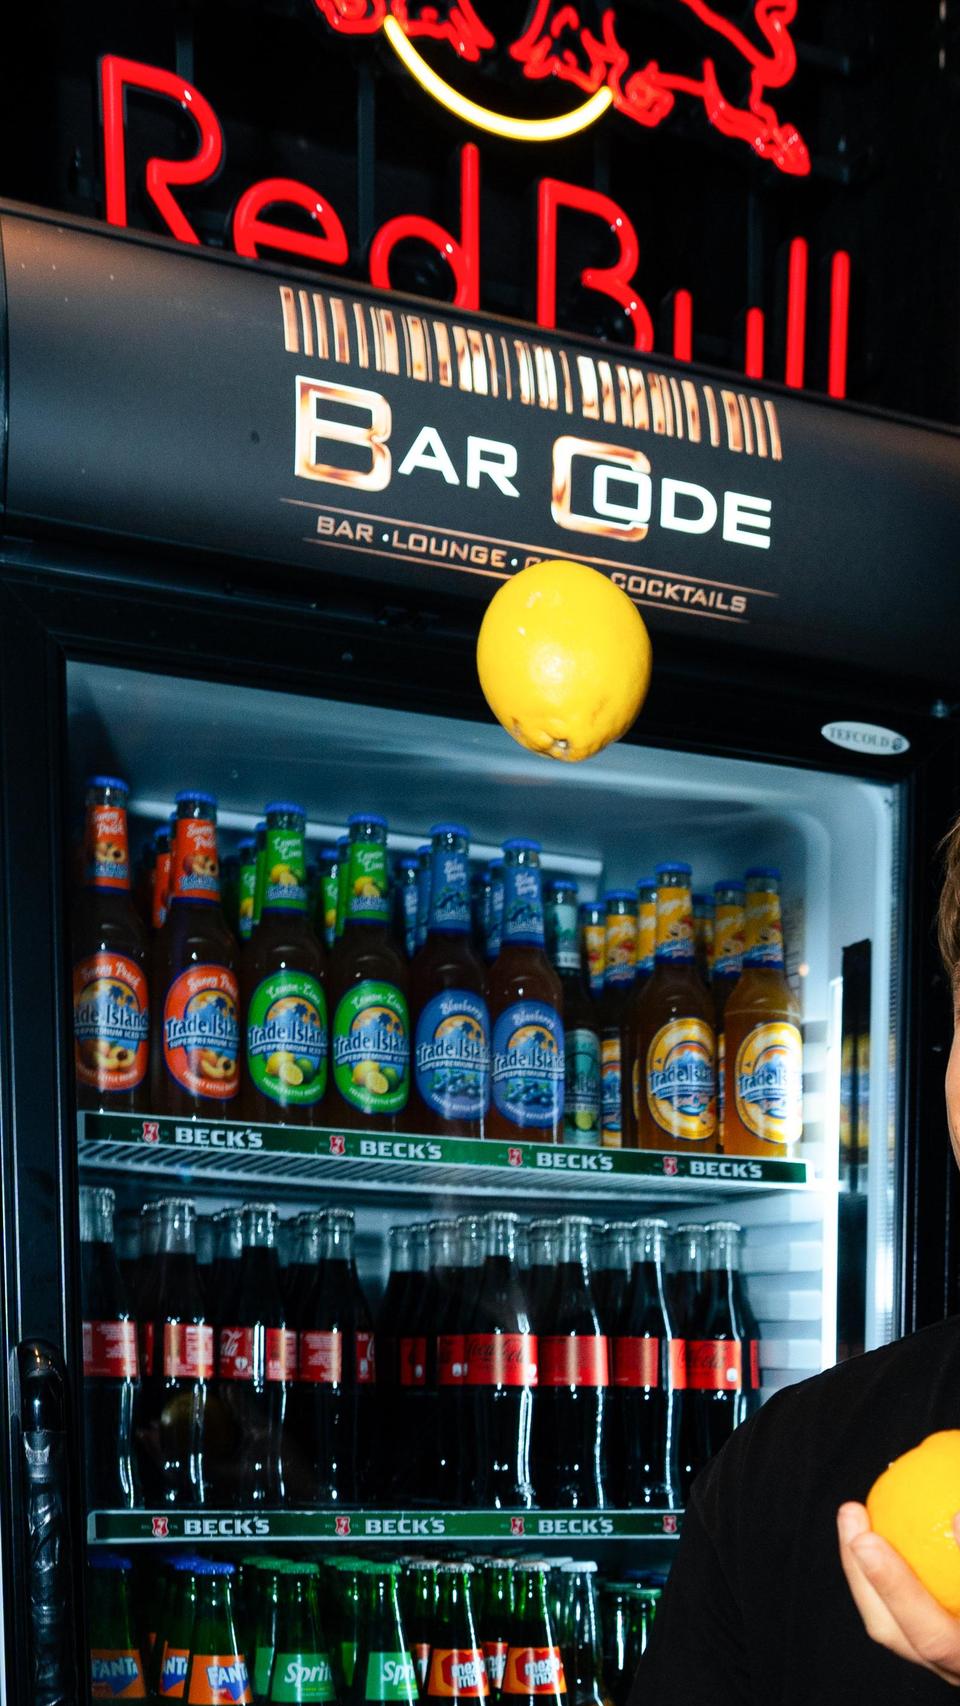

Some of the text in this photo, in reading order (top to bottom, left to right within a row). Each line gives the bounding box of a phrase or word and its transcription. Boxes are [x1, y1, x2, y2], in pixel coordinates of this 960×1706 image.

[100, 54, 481, 311] Red
[317, 514, 748, 613] BAR LOUNGE COCKTAILS
[105, 1003, 150, 1028] Island
[494, 1049, 528, 1073] rade
[175, 1126, 763, 1179] BECK'S BECK'S BECK'S BECK'S
[184, 1516, 614, 1536] BECK'S BECK'S BECK'S
